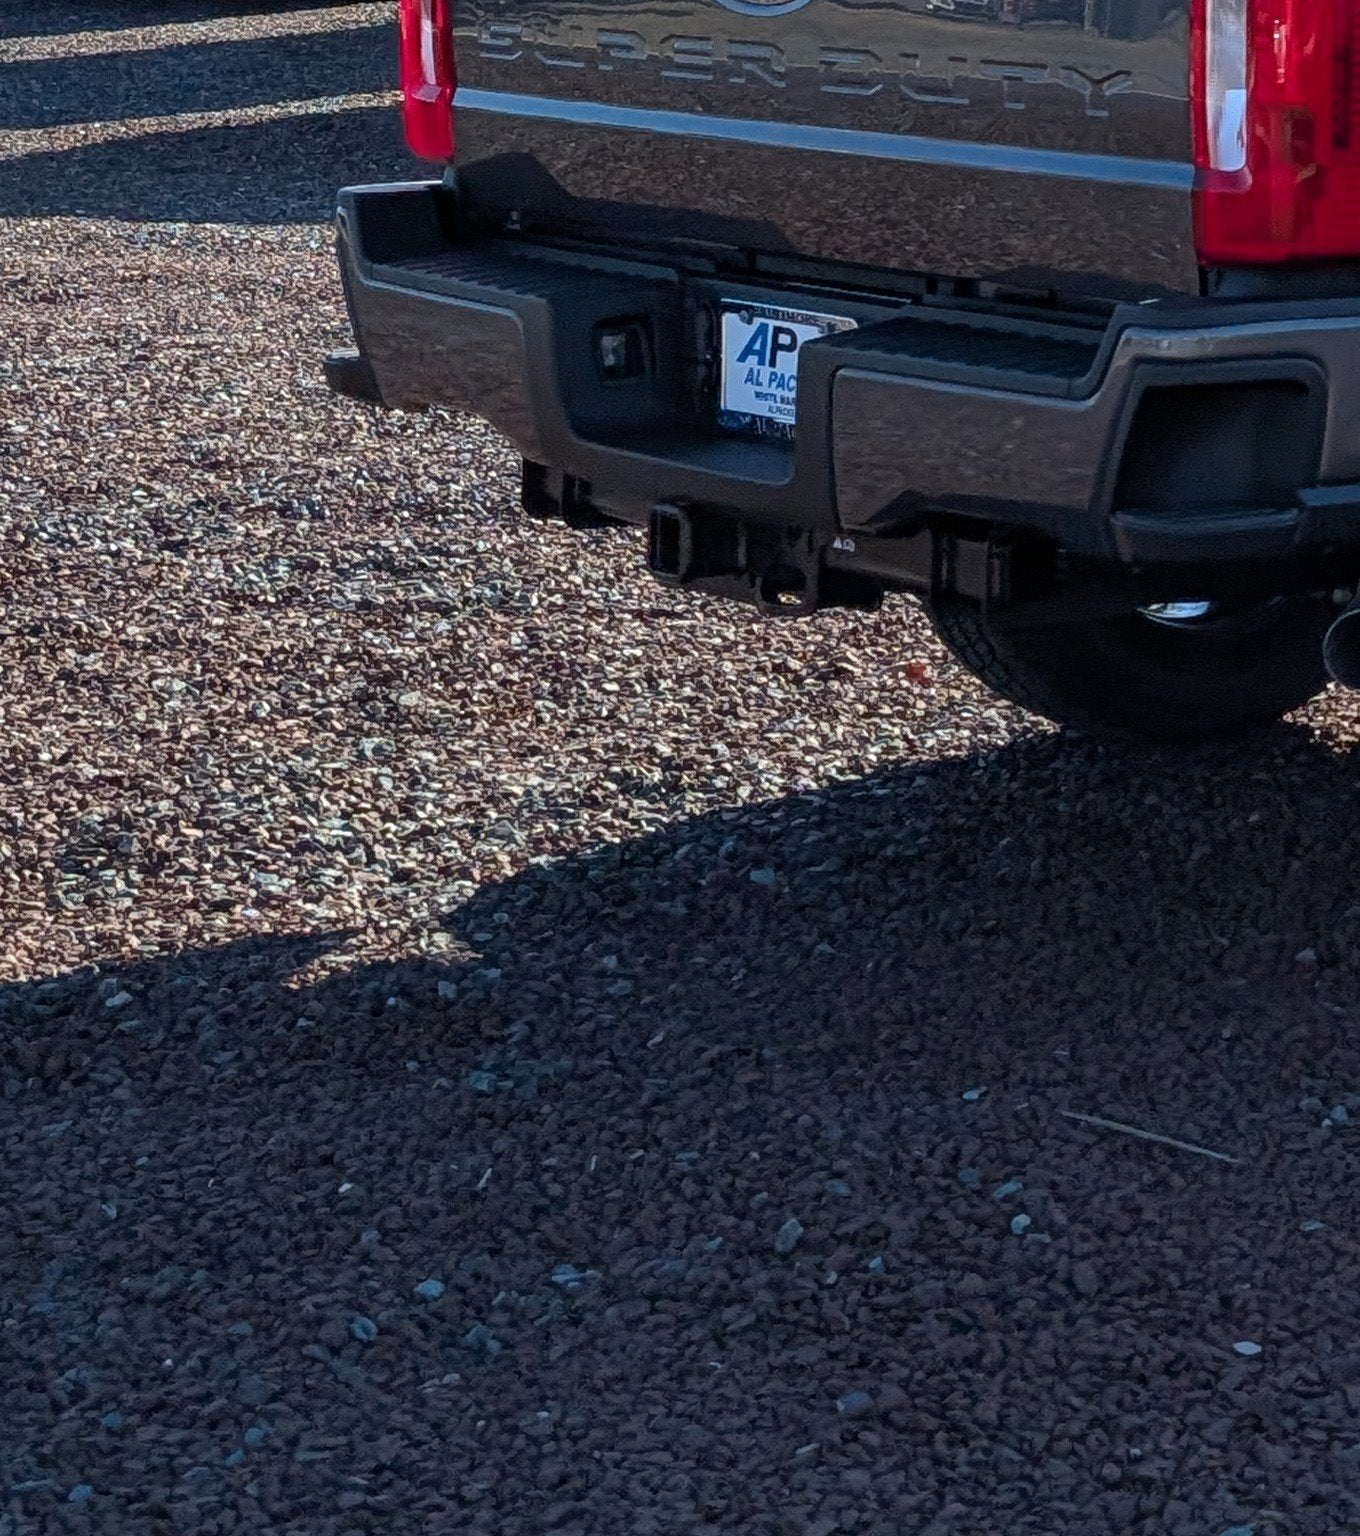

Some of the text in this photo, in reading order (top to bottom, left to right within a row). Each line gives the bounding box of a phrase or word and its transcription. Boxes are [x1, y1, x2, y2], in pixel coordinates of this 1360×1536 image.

[479, 17, 1134, 117] SUPER DUTY
[736, 321, 798, 369] AP
[744, 367, 796, 392] AL PAC
